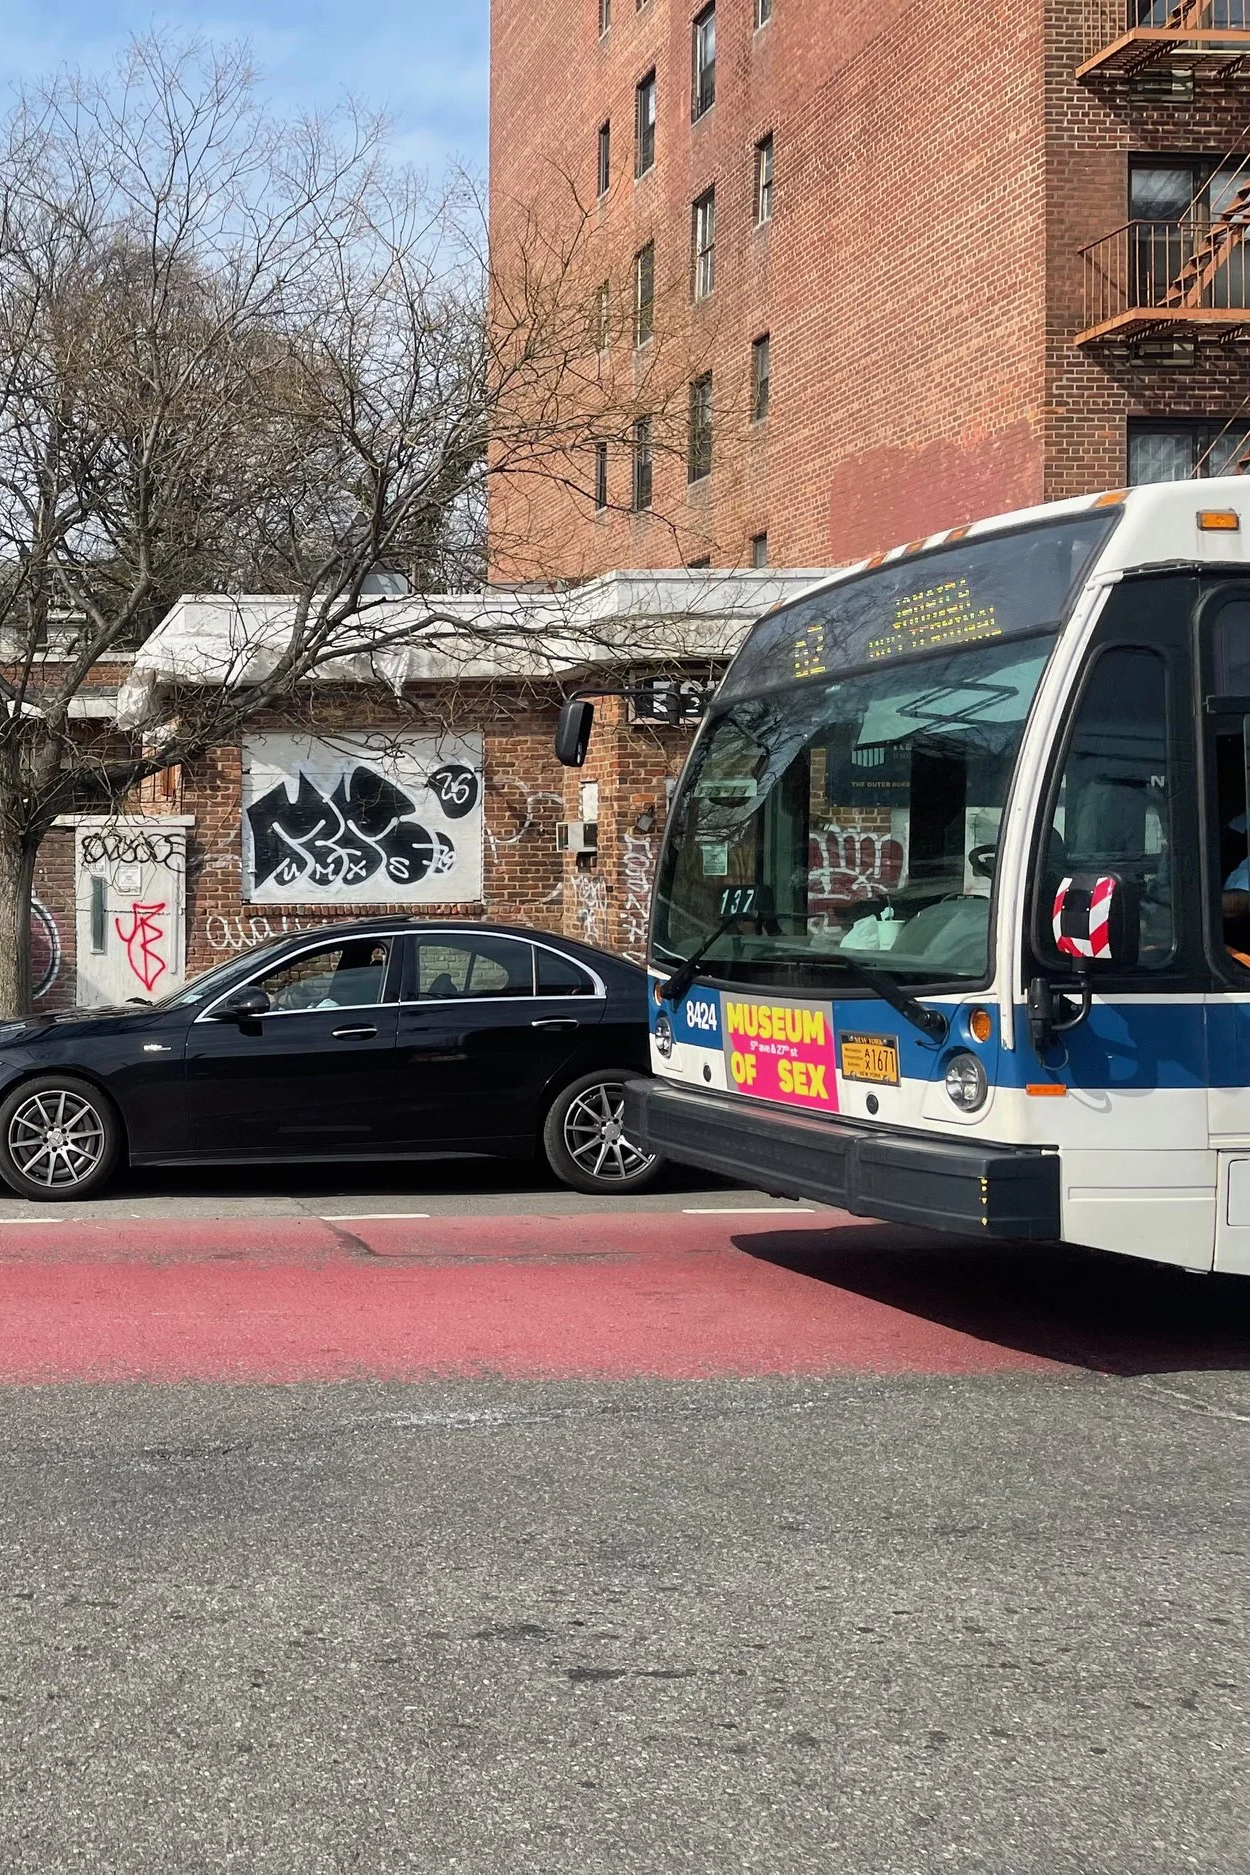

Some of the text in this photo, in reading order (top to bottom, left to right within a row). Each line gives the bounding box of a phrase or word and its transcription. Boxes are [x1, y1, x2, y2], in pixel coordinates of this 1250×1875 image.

[720, 889, 754, 915] 137
[686, 1000, 717, 1031] 8424
[726, 1001, 826, 1046] MUSEUM
[730, 1050, 829, 1099] OF SEX
[871, 1048, 895, 1073] 1671
